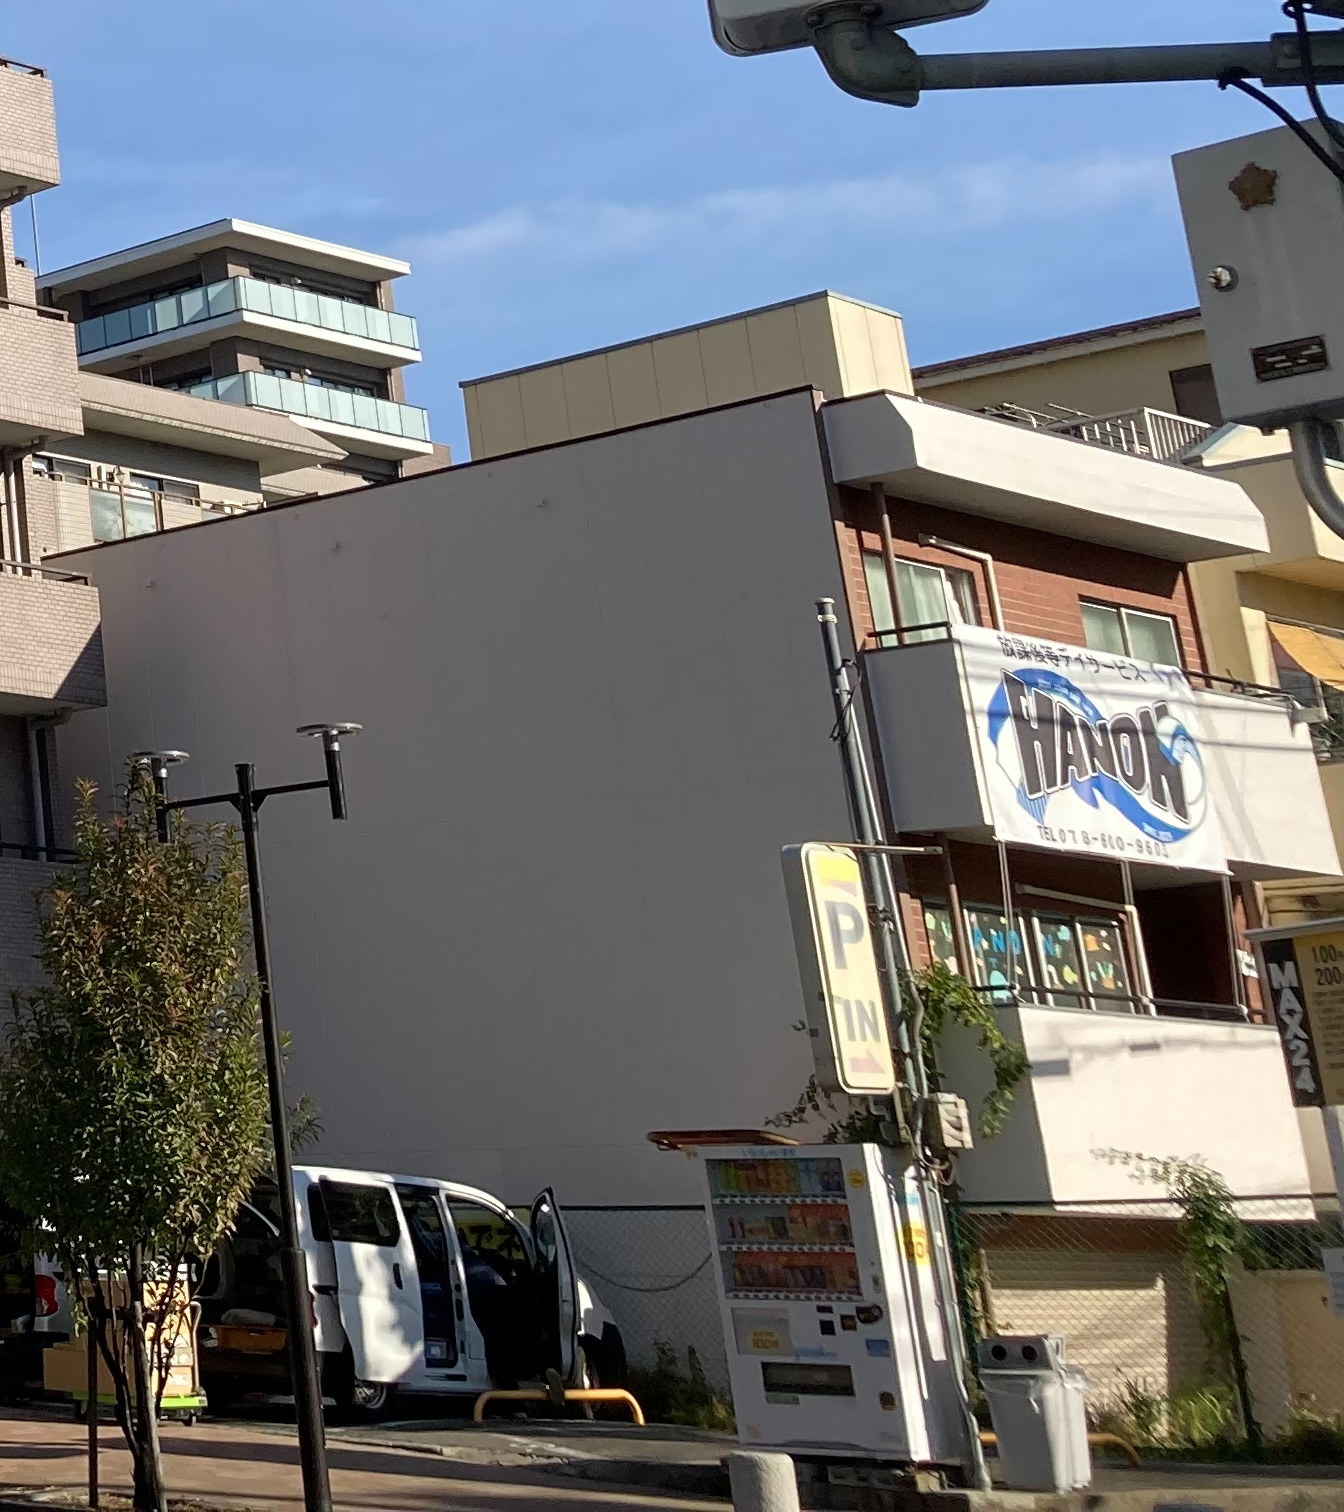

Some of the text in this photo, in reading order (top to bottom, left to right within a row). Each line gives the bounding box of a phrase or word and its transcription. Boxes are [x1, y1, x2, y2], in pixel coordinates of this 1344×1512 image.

[1000, 668, 1189, 825] HANON
[825, 900, 864, 969] P
[843, 999, 881, 1042] IN
[1267, 960, 1316, 1094] MAX24
